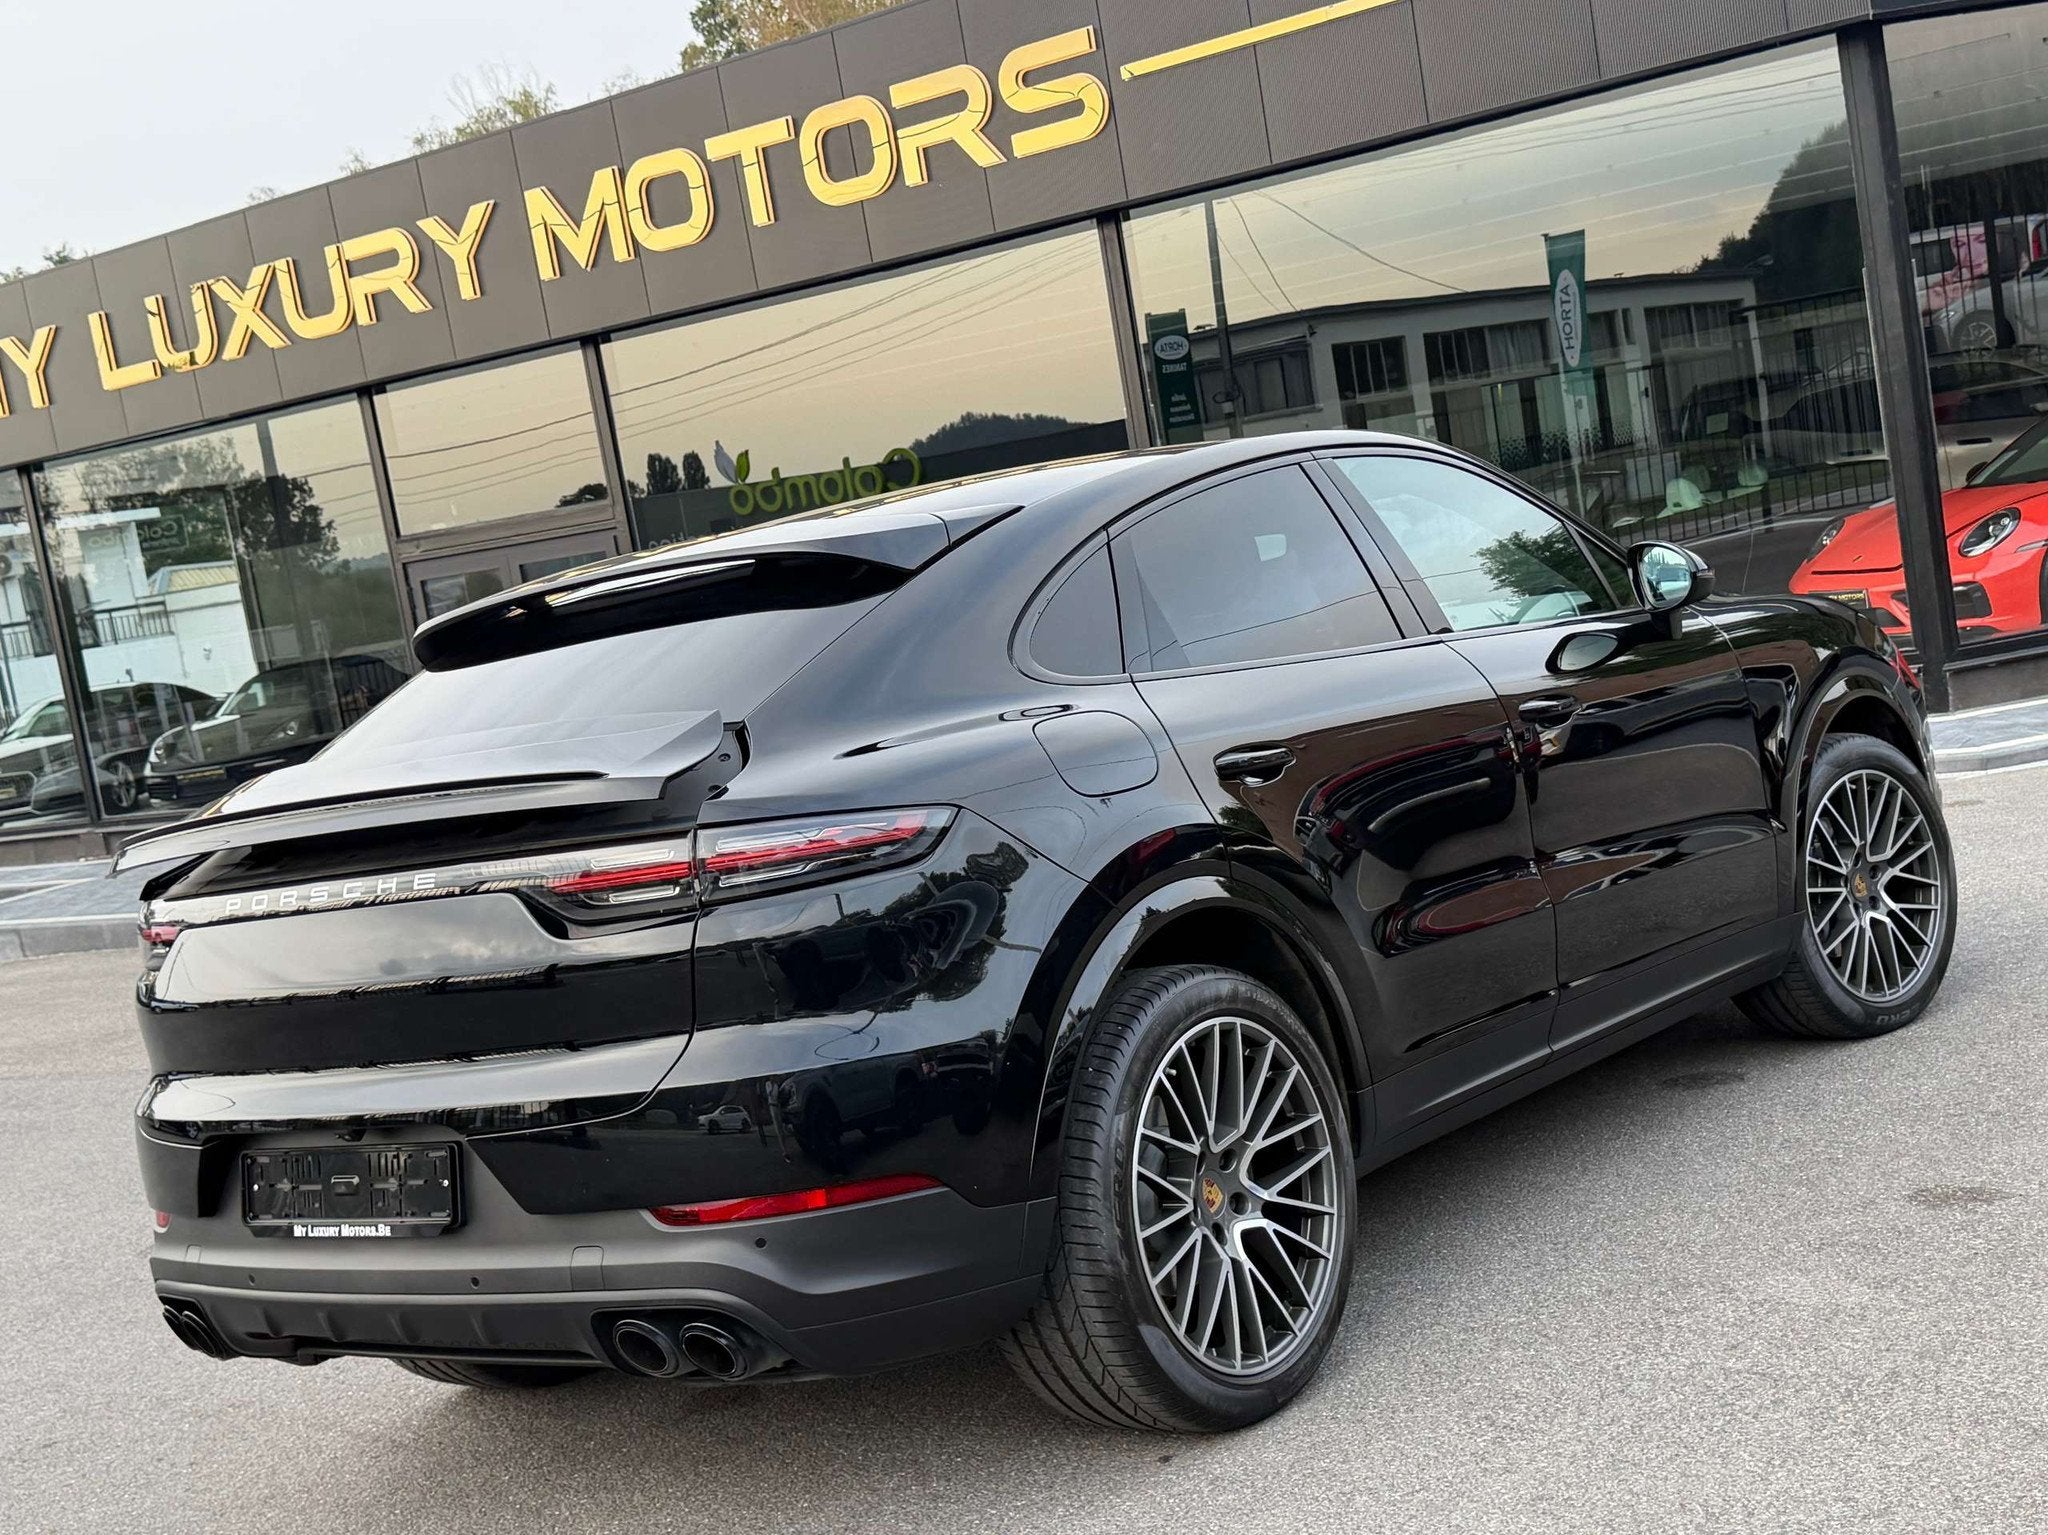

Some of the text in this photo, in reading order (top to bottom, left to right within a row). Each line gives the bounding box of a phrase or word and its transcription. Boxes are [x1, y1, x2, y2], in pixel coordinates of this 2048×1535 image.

[0, 25, 1111, 419] Y LUXURY MOTORS
[1559, 284, 1575, 350] HORTA
[224, 872, 437, 915] PORSCHE
[308, 1224, 340, 1237] LUXURY
